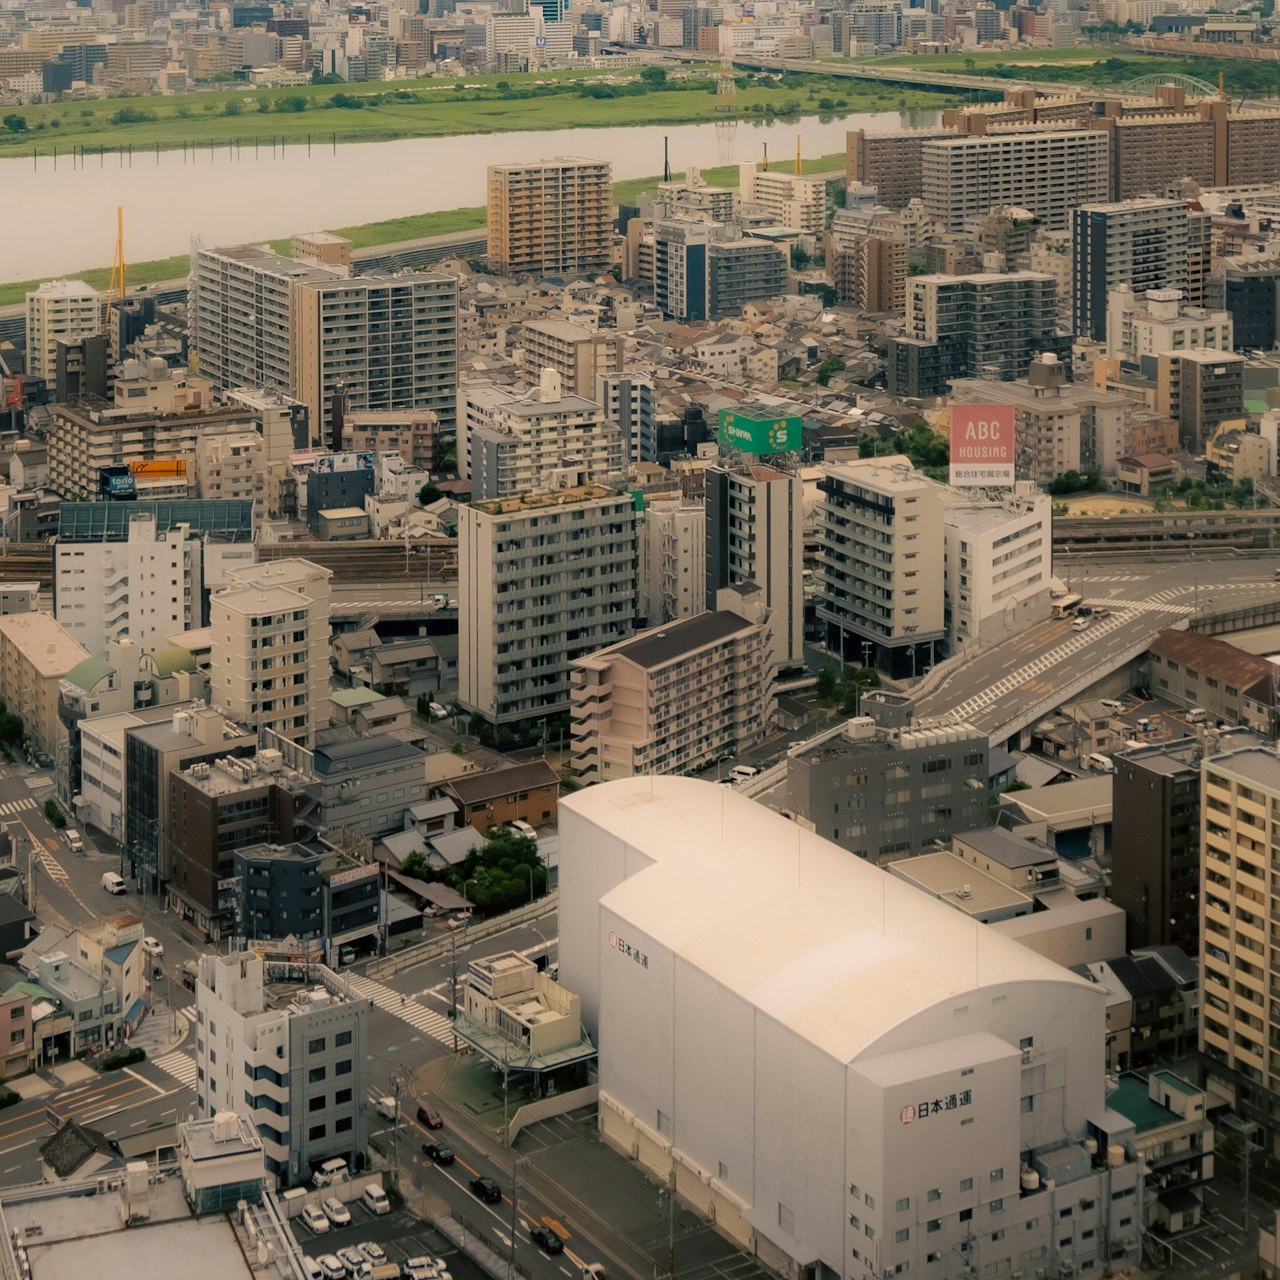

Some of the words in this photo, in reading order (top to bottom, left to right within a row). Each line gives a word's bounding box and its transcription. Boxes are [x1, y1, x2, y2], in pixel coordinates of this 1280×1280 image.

[965, 421, 1000, 440] ABC
[959, 446, 1007, 458] HOUSING
[955, 470, 1010, 479] 総合住宅展示場
[618, 937, 649, 970] 日本通運
[918, 1089, 972, 1119] 日本通運
